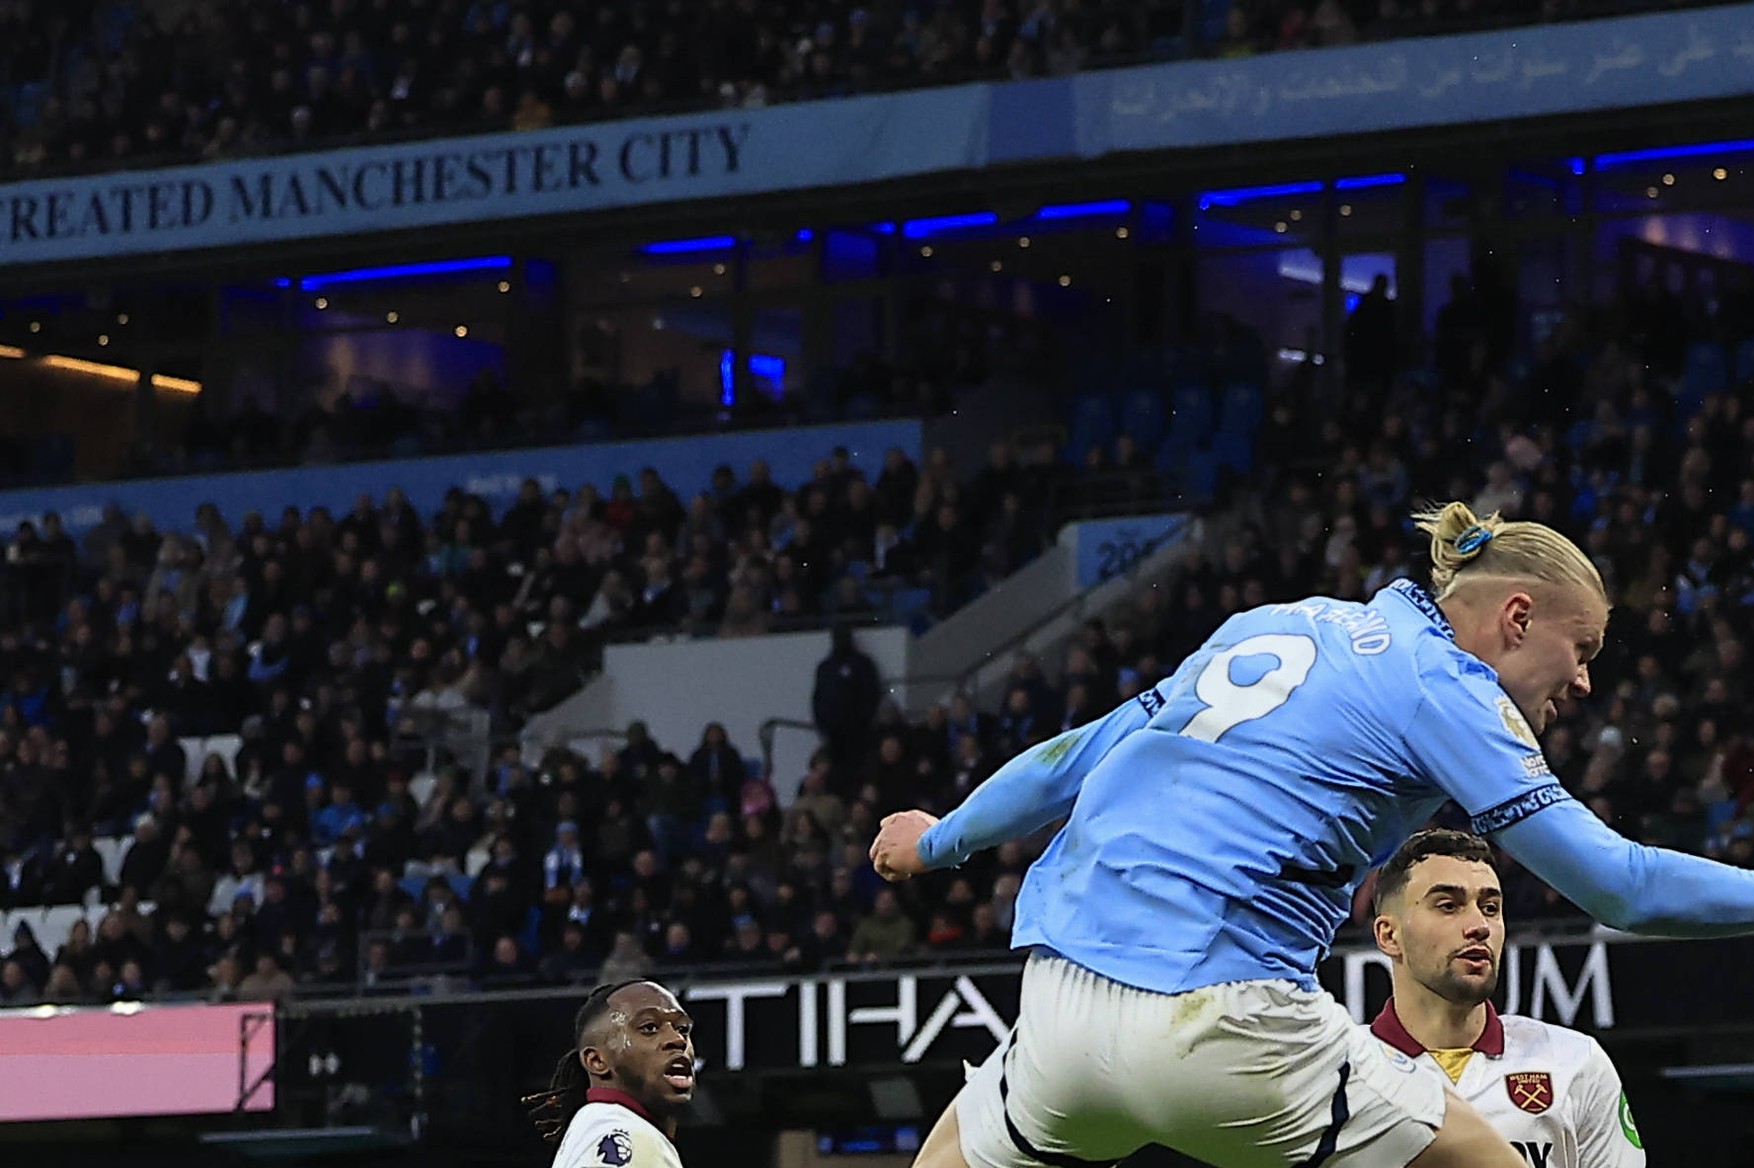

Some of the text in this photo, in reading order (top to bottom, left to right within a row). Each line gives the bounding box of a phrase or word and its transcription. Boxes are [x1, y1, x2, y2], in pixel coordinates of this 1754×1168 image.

[0, 121, 753, 242] REATED MANCHESTER CITY
[1176, 633, 1319, 744] 9
[684, 973, 1012, 1073] TIHA
